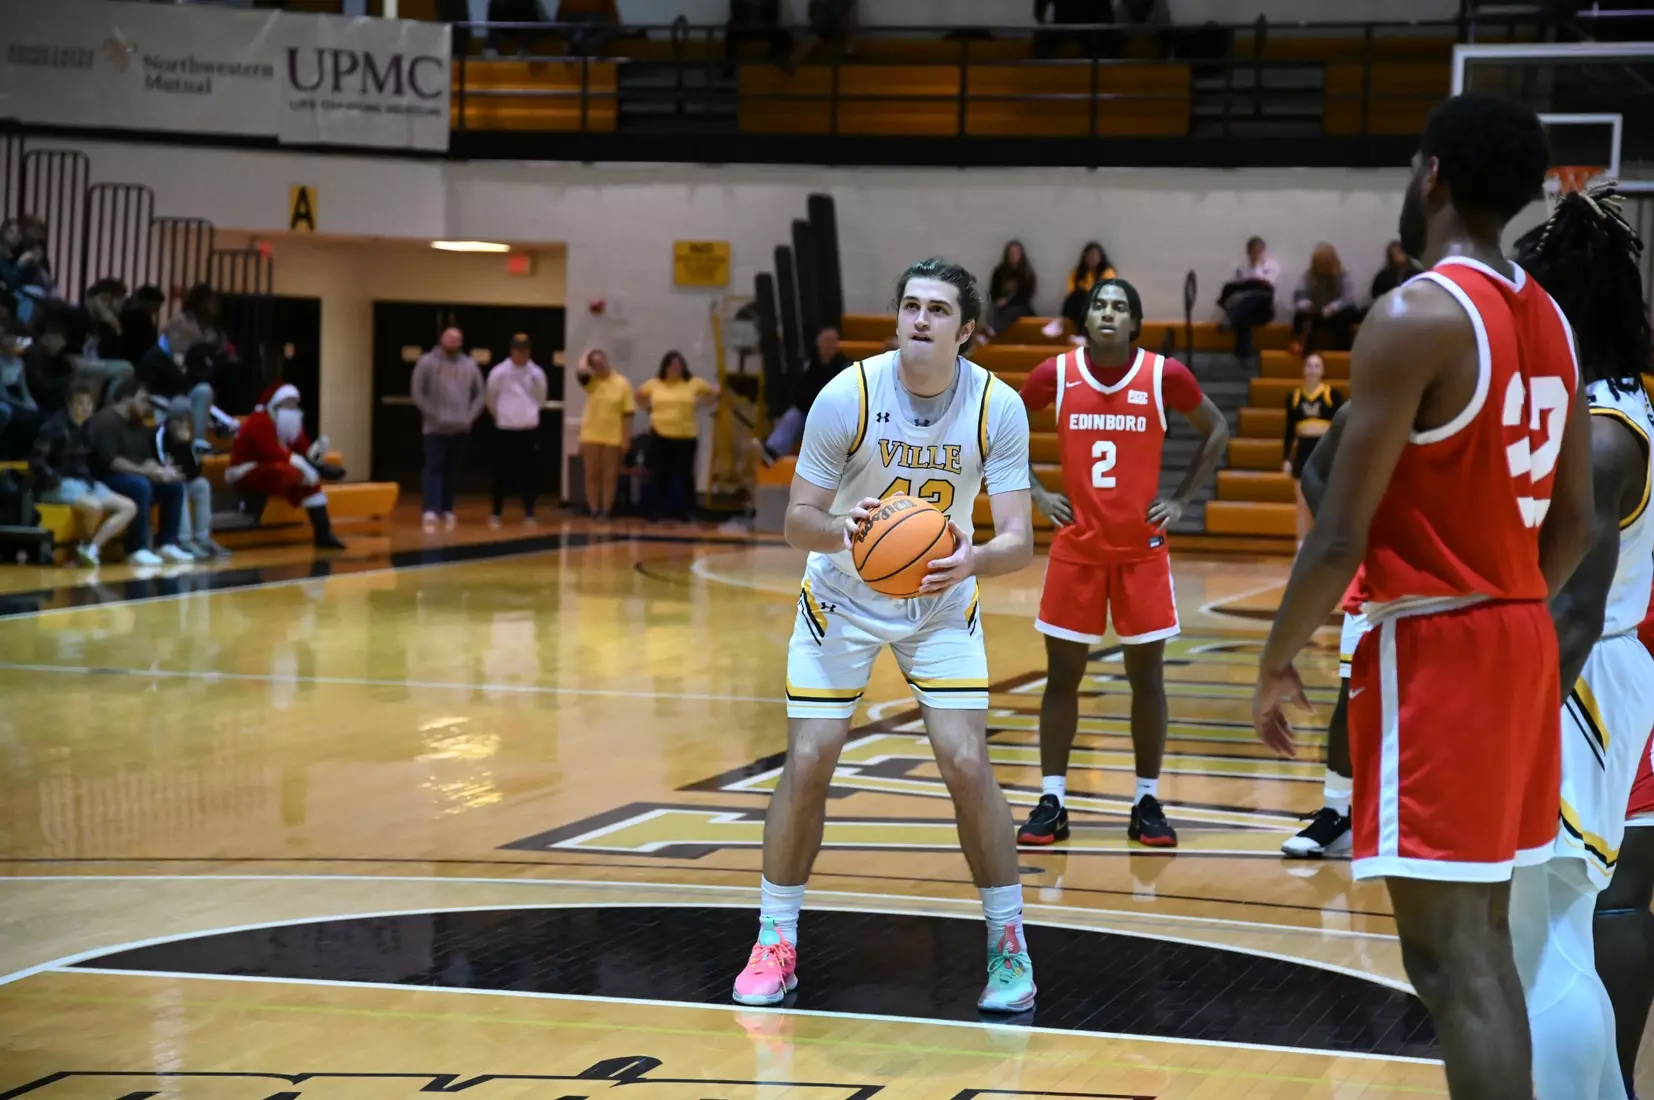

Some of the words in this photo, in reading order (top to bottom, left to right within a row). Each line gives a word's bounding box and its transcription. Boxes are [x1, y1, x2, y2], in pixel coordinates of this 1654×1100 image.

[143, 53, 274, 79] Northwestern
[286, 46, 444, 99] UPMC
[144, 73, 213, 95] Mutual
[290, 185, 314, 231] A
[1069, 413, 1147, 432] EDINBORO
[878, 439, 962, 474] VILLE
[1091, 440, 1117, 488] 2
